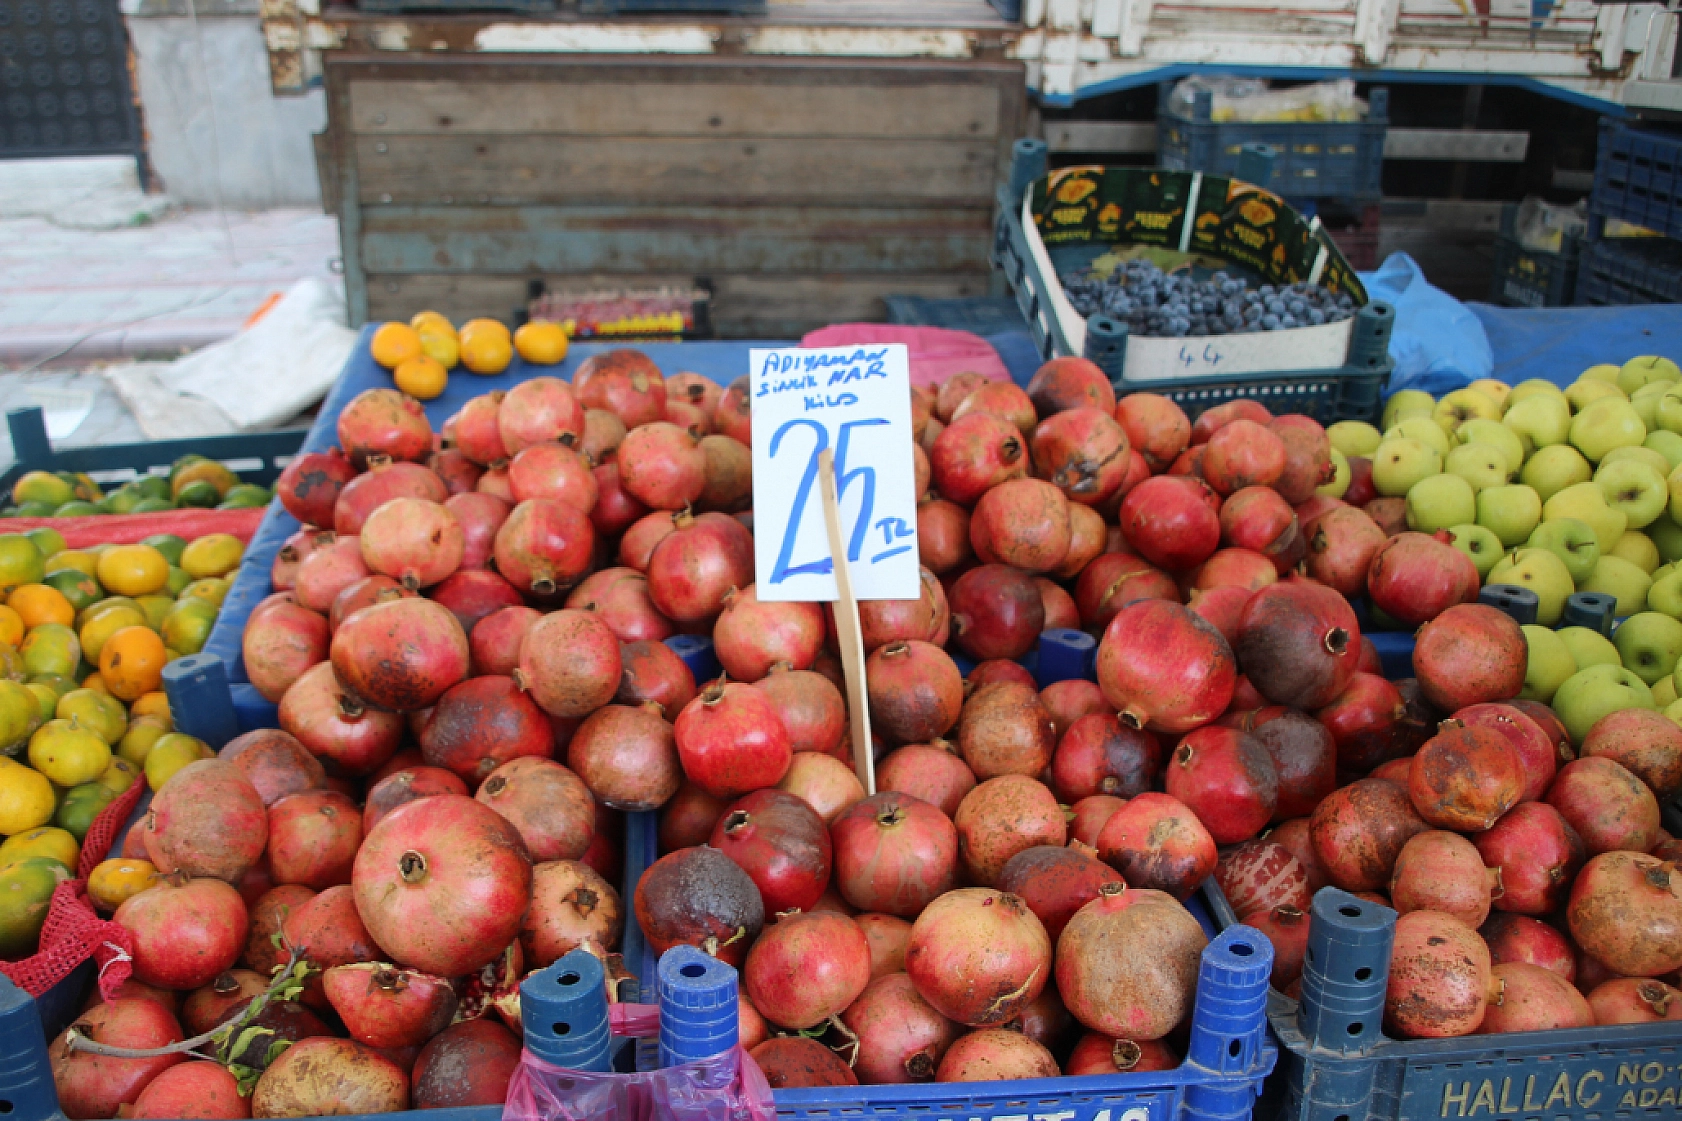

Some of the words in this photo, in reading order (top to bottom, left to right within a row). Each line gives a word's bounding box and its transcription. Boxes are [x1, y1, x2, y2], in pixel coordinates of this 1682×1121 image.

[827, 360, 888, 387] NAR
[769, 418, 891, 584] 25
[1441, 1070, 1605, 1118] HALLAC
[1617, 1086, 1682, 1109] ADA
